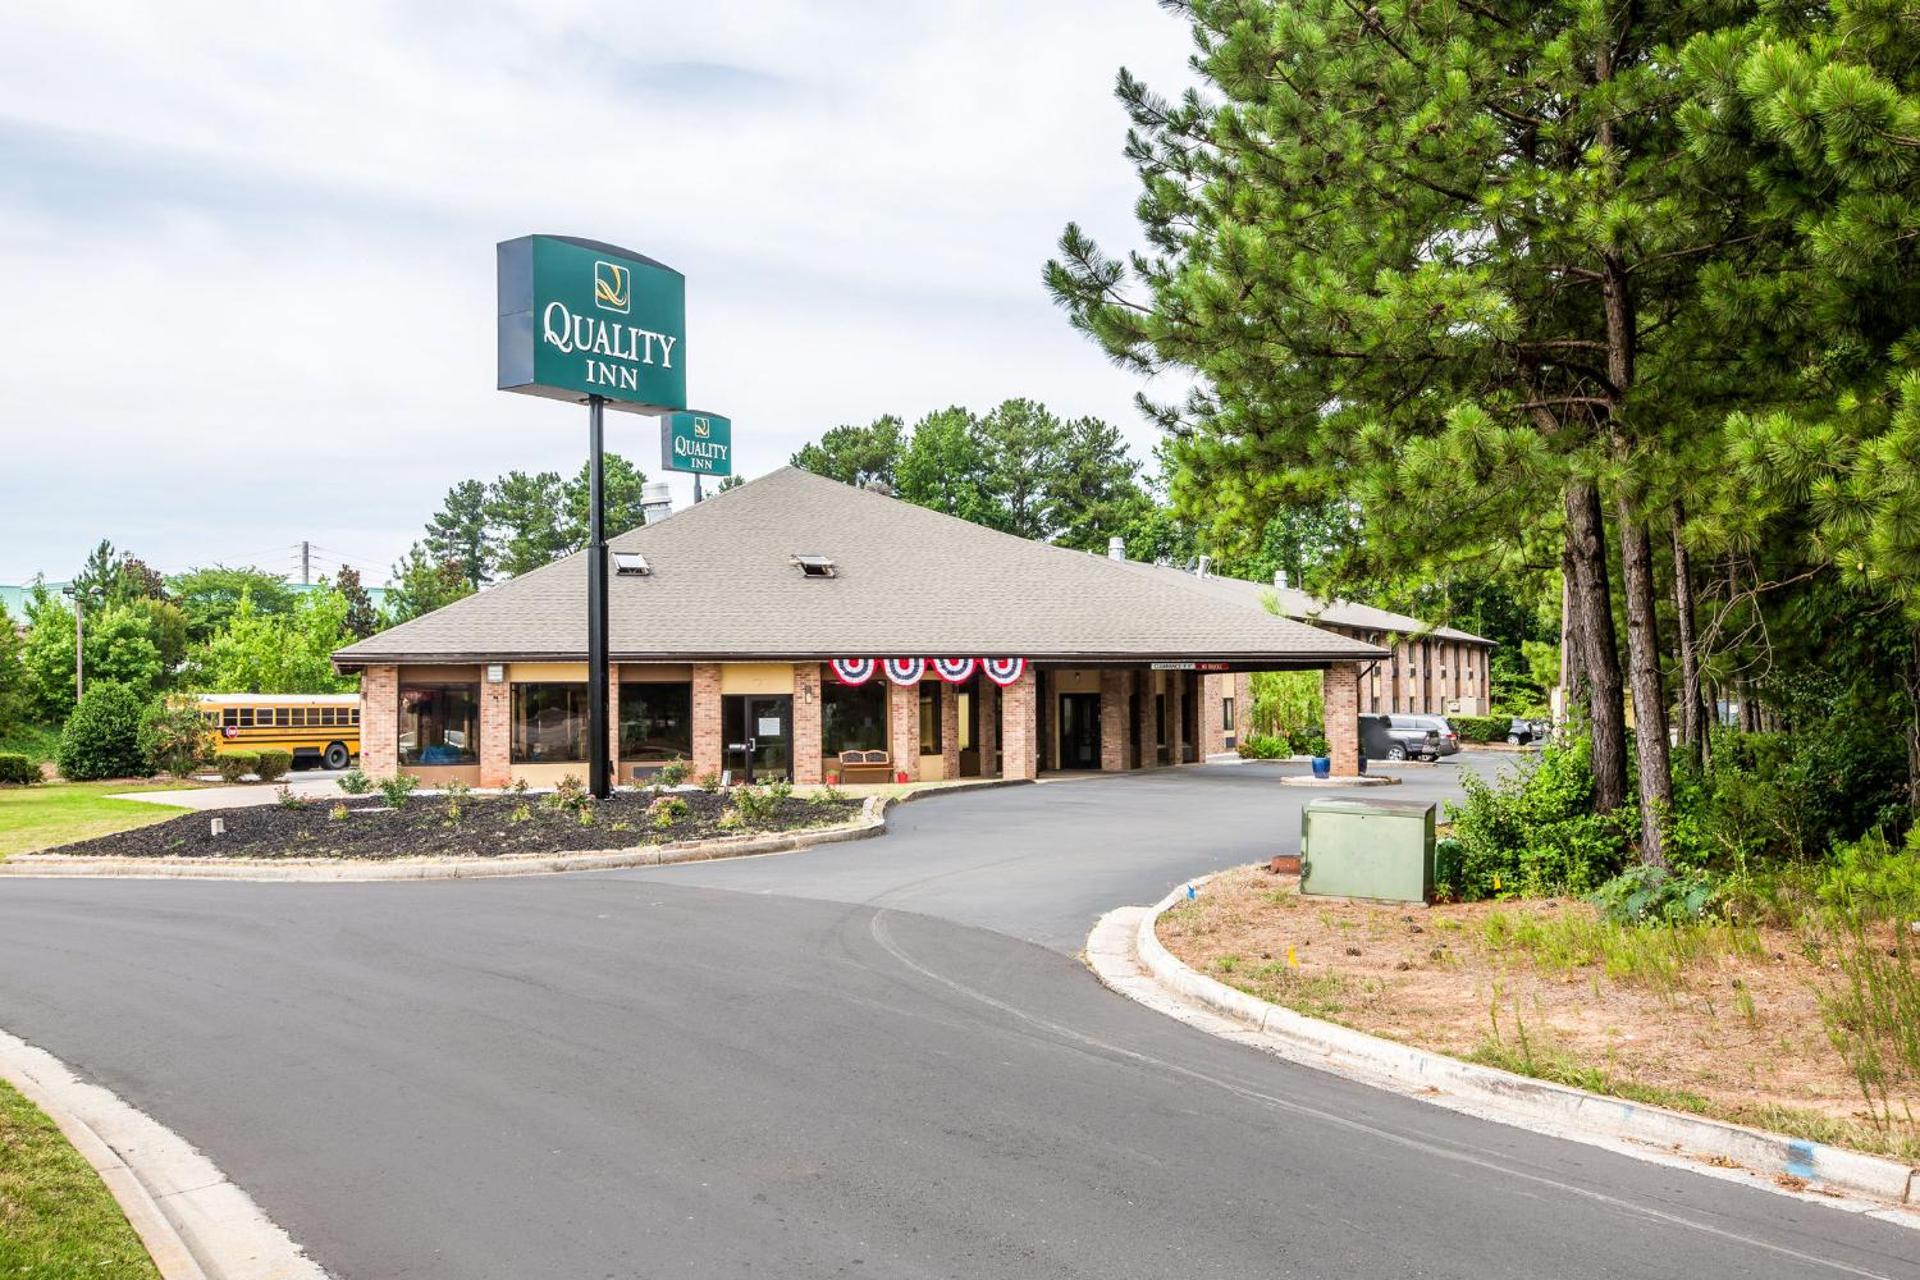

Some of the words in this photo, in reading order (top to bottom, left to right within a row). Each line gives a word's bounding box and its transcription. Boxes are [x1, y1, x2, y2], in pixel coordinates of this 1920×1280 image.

[543, 301, 677, 369] QUALITY
[586, 360, 638, 391] INN
[675, 435, 728, 460] QUALITY
[691, 457, 713, 470] INN
